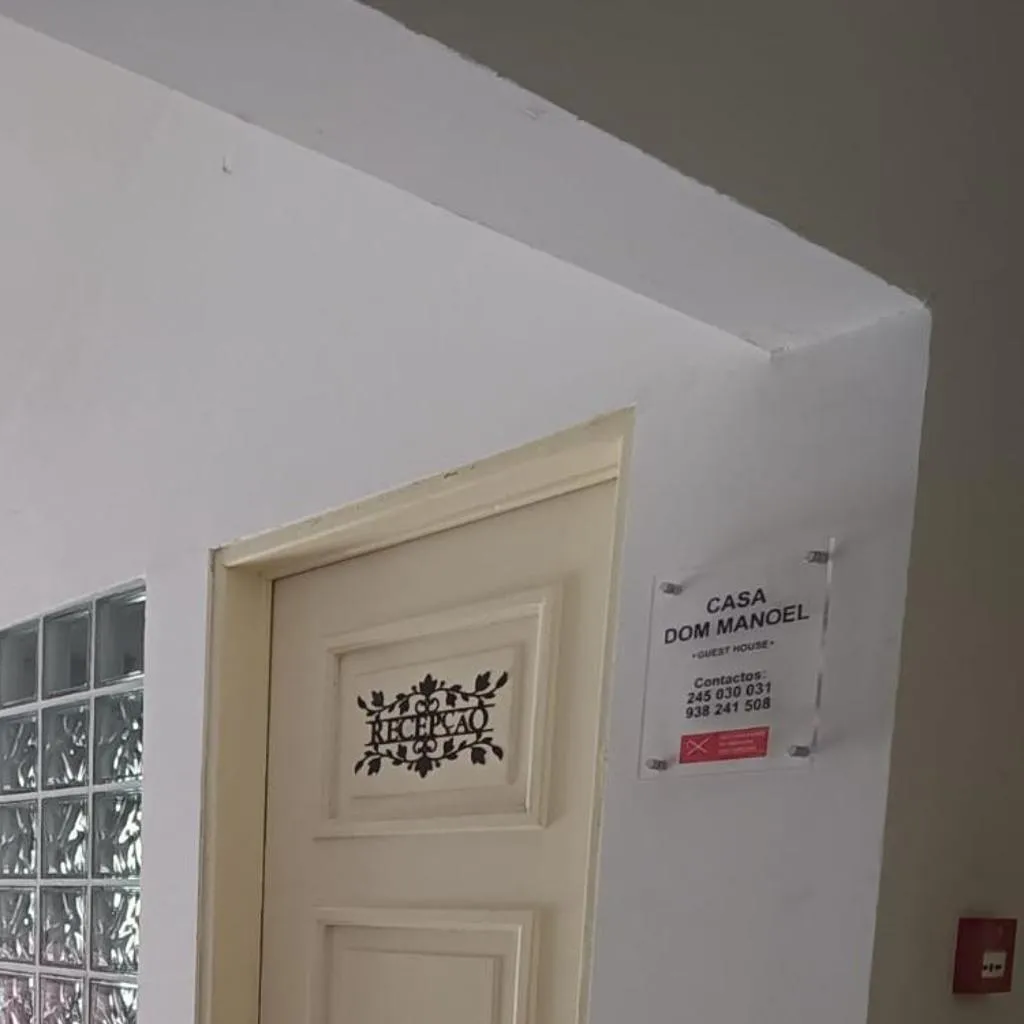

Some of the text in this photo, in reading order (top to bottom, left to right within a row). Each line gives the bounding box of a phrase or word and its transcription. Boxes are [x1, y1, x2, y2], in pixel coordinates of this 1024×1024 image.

[706, 588, 767, 614] CASA
[664, 603, 810, 645] DOM MANOEL
[694, 670, 767, 688] Contactos:
[687, 681, 771, 704] 245 030 031
[686, 697, 771, 718] 938 241 508
